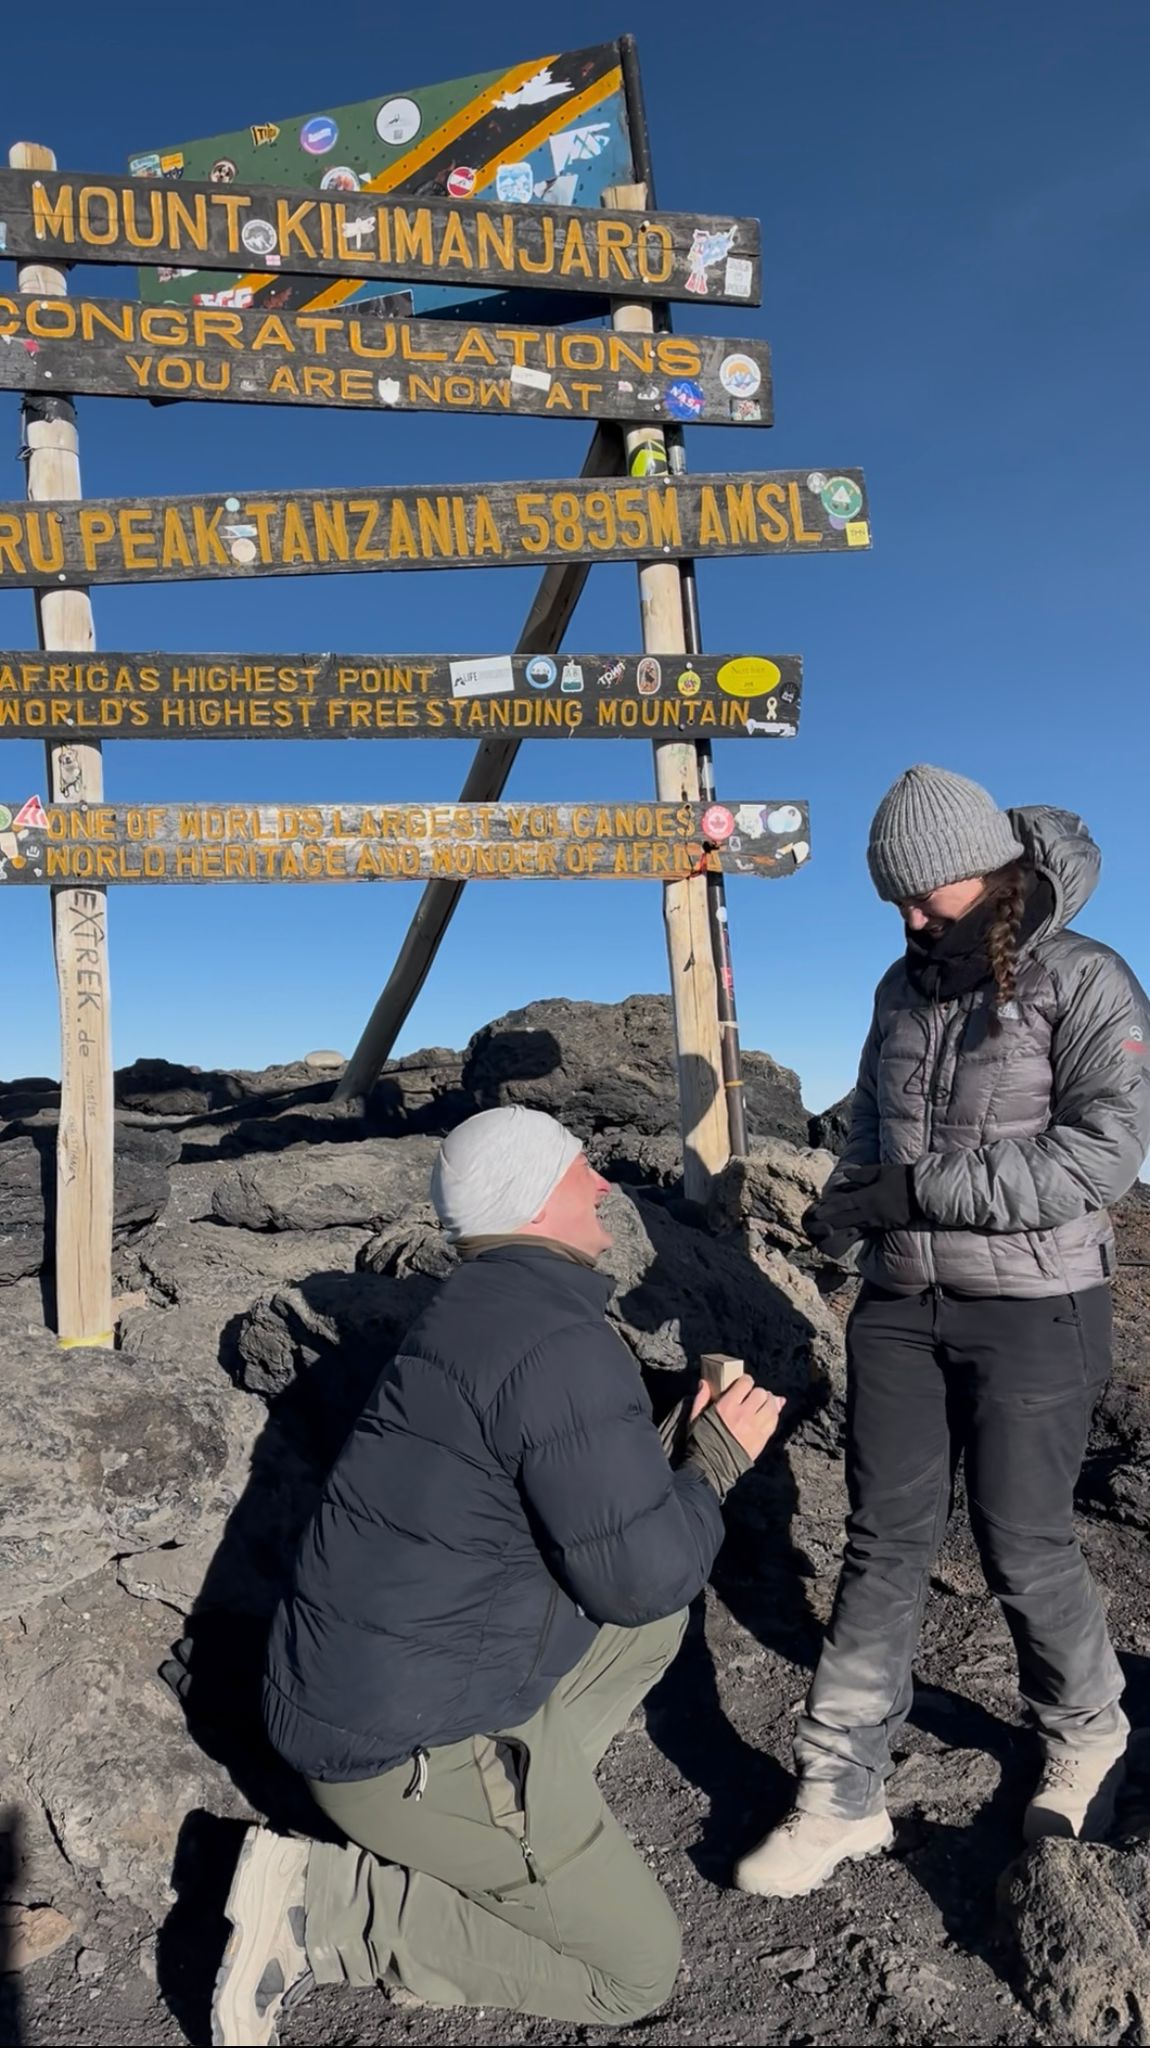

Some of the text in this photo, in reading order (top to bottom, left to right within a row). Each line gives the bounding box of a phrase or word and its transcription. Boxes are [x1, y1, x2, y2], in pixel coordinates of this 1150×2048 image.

[32, 183, 674, 284] MOUNT KILIMANJARO
[0, 296, 702, 377] CONGRATULATIONS
[125, 355, 603, 411] YOU ARE NOW AT
[79, 504, 231, 571] PEAK
[245, 494, 502, 565] TANZANIA
[515, 486, 682, 554] 5895M
[699, 481, 823, 545] AMSL
[171, 664, 320, 694] HIGHEST
[337, 665, 437, 694] POINT
[0, 697, 150, 727] WORLD'S
[162, 697, 317, 728] HIGHEST
[598, 697, 750, 728] MOUNTAIN
[47, 807, 118, 842] ONE
[126, 807, 168, 842] OF
[332, 806, 496, 842] LARGEST
[508, 803, 696, 840] VOLCANOES
[46, 844, 166, 878] WORLD
[176, 843, 347, 878] HERITAGE
[355, 842, 420, 877] AND
[432, 842, 557, 876] WONDER
[566, 841, 602, 874] OF
